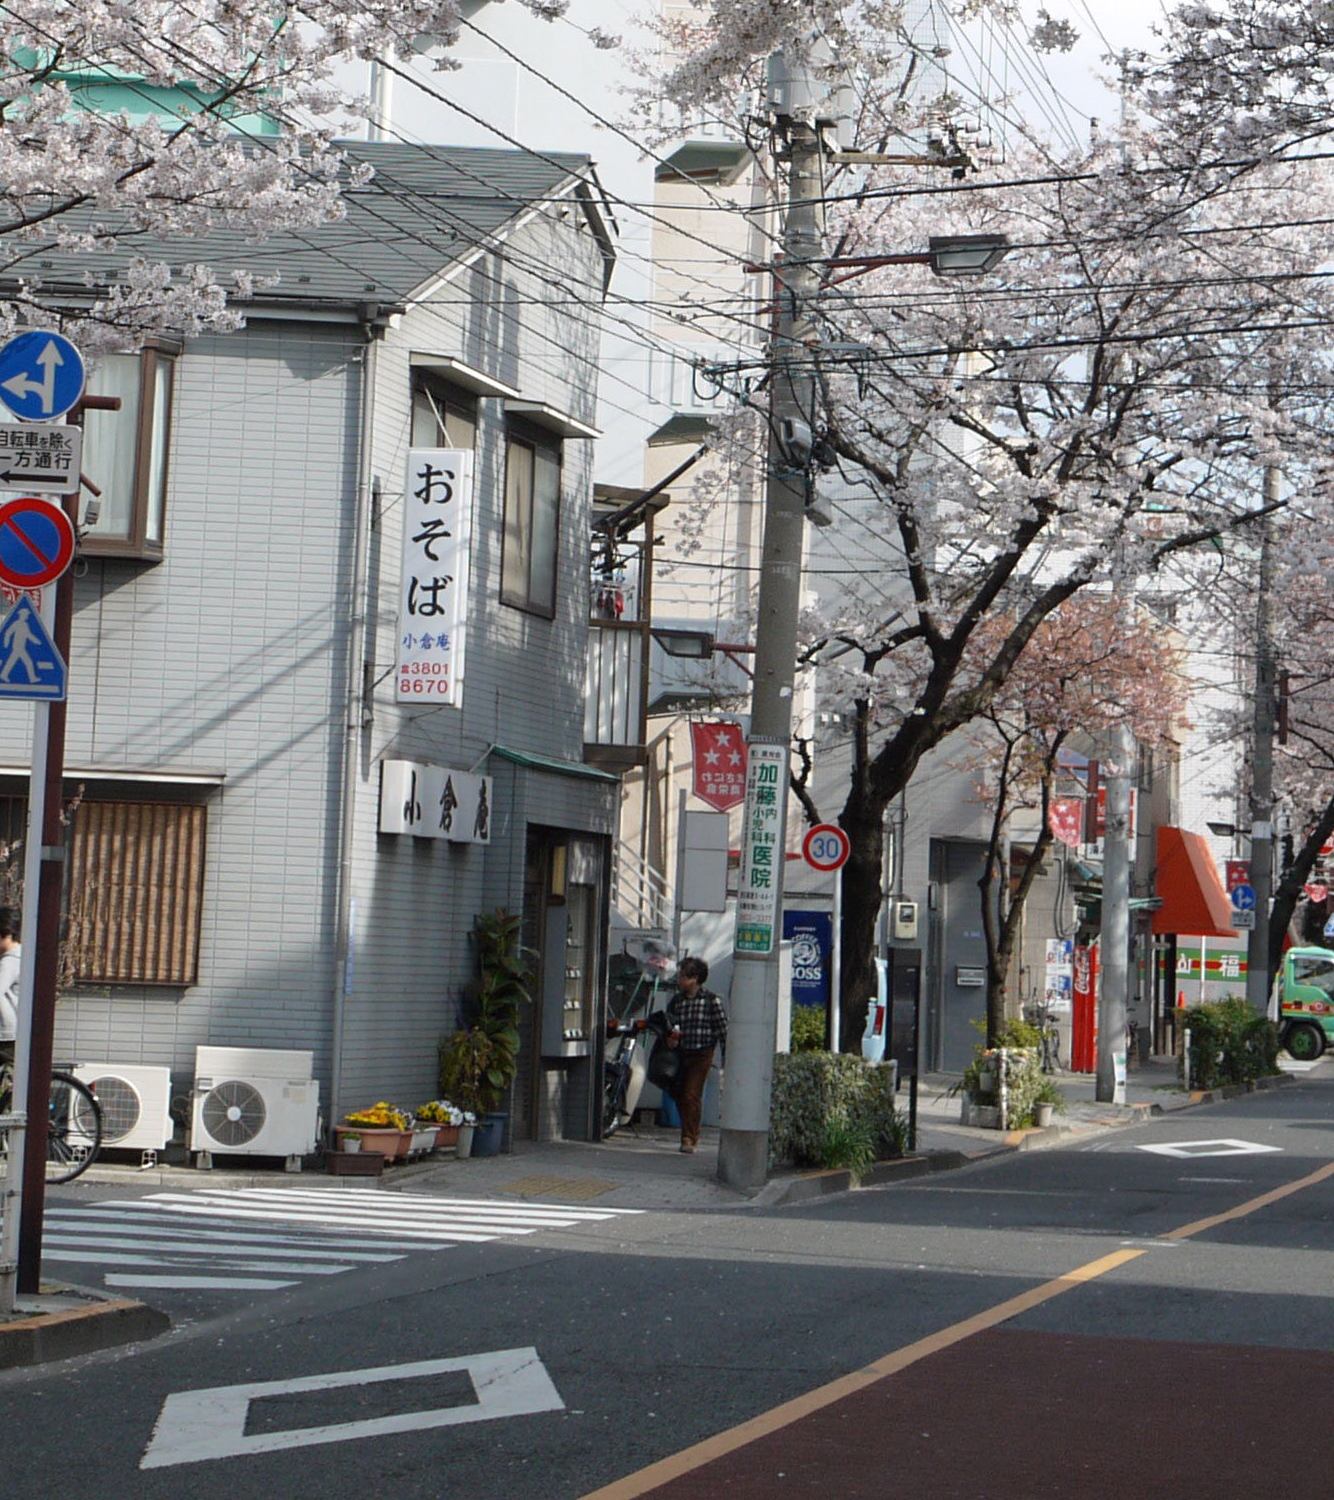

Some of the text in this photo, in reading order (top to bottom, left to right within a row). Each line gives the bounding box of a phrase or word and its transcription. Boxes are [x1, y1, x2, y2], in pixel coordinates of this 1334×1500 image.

[407, 463, 455, 617] おそば
[402, 632, 451, 652] 小倉庵
[411, 661, 449, 675] 3801
[400, 679, 449, 694] 8670
[403, 770, 490, 840] 小倉庵
[813, 838, 839, 858] 30
[750, 846, 773, 889] 医院
